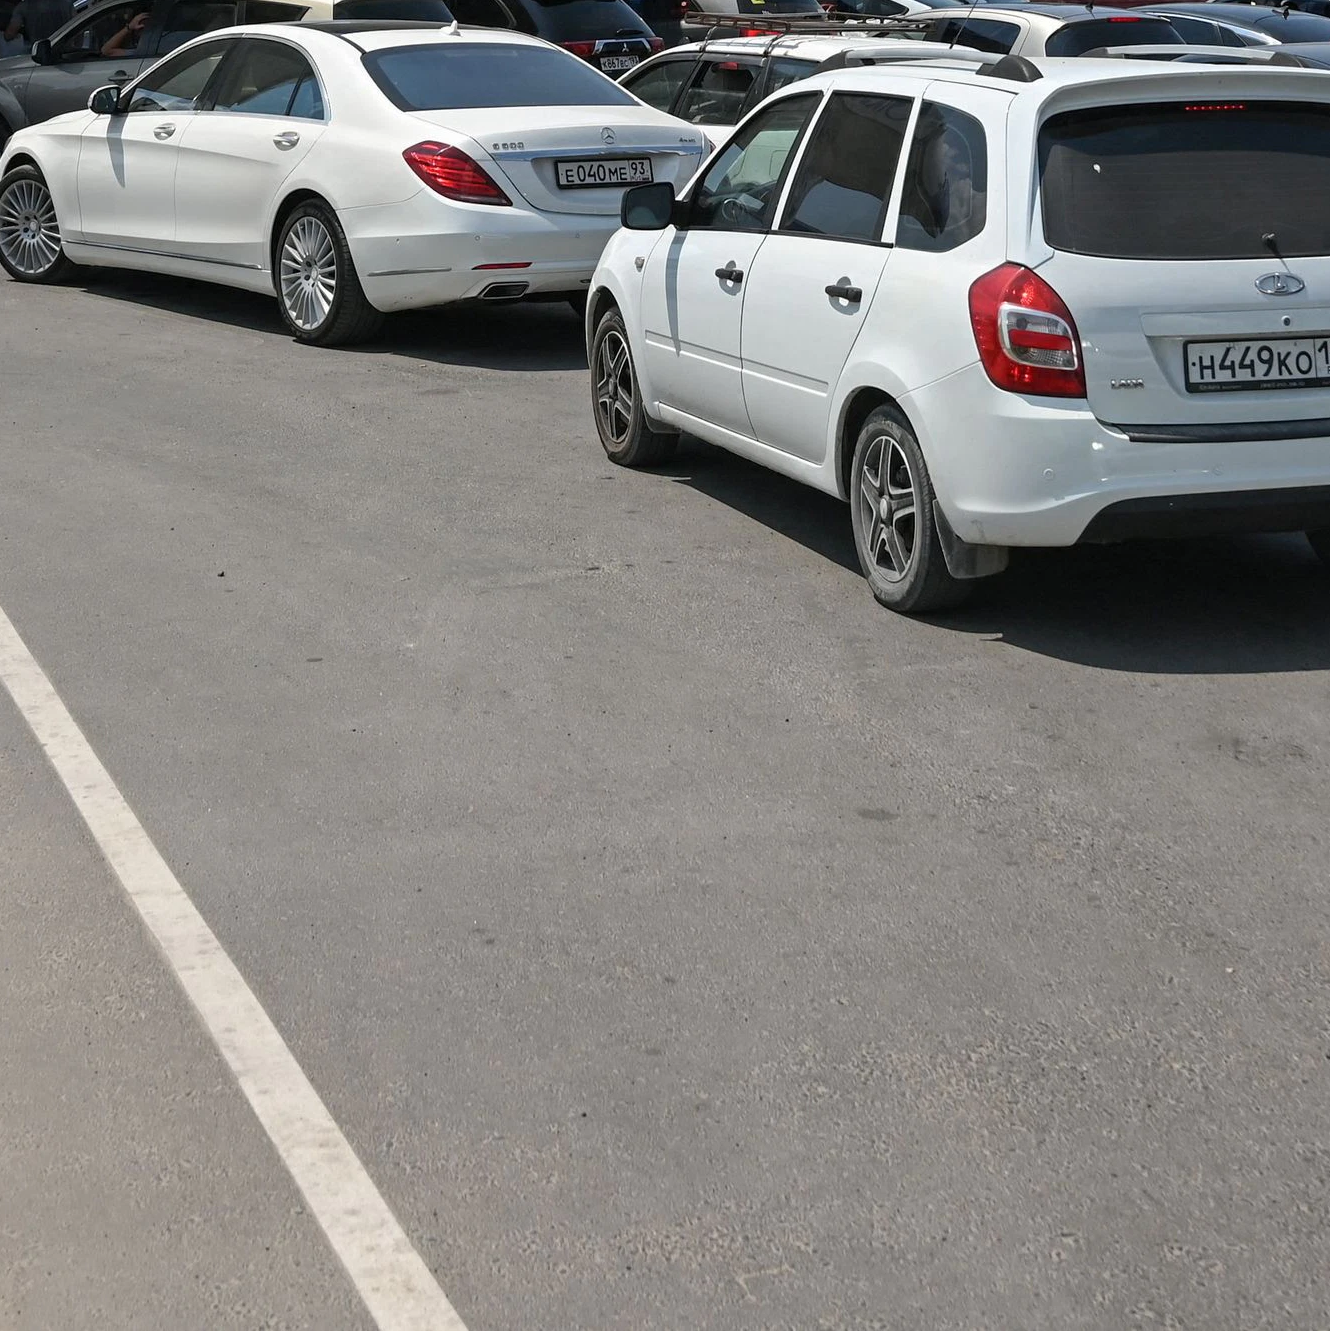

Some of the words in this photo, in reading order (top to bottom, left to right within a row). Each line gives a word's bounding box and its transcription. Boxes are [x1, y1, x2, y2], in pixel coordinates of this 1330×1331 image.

[566, 164, 628, 183] Е040МЕ
[630, 161, 645, 175] 93
[1199, 345, 1312, 380] Н449КО
